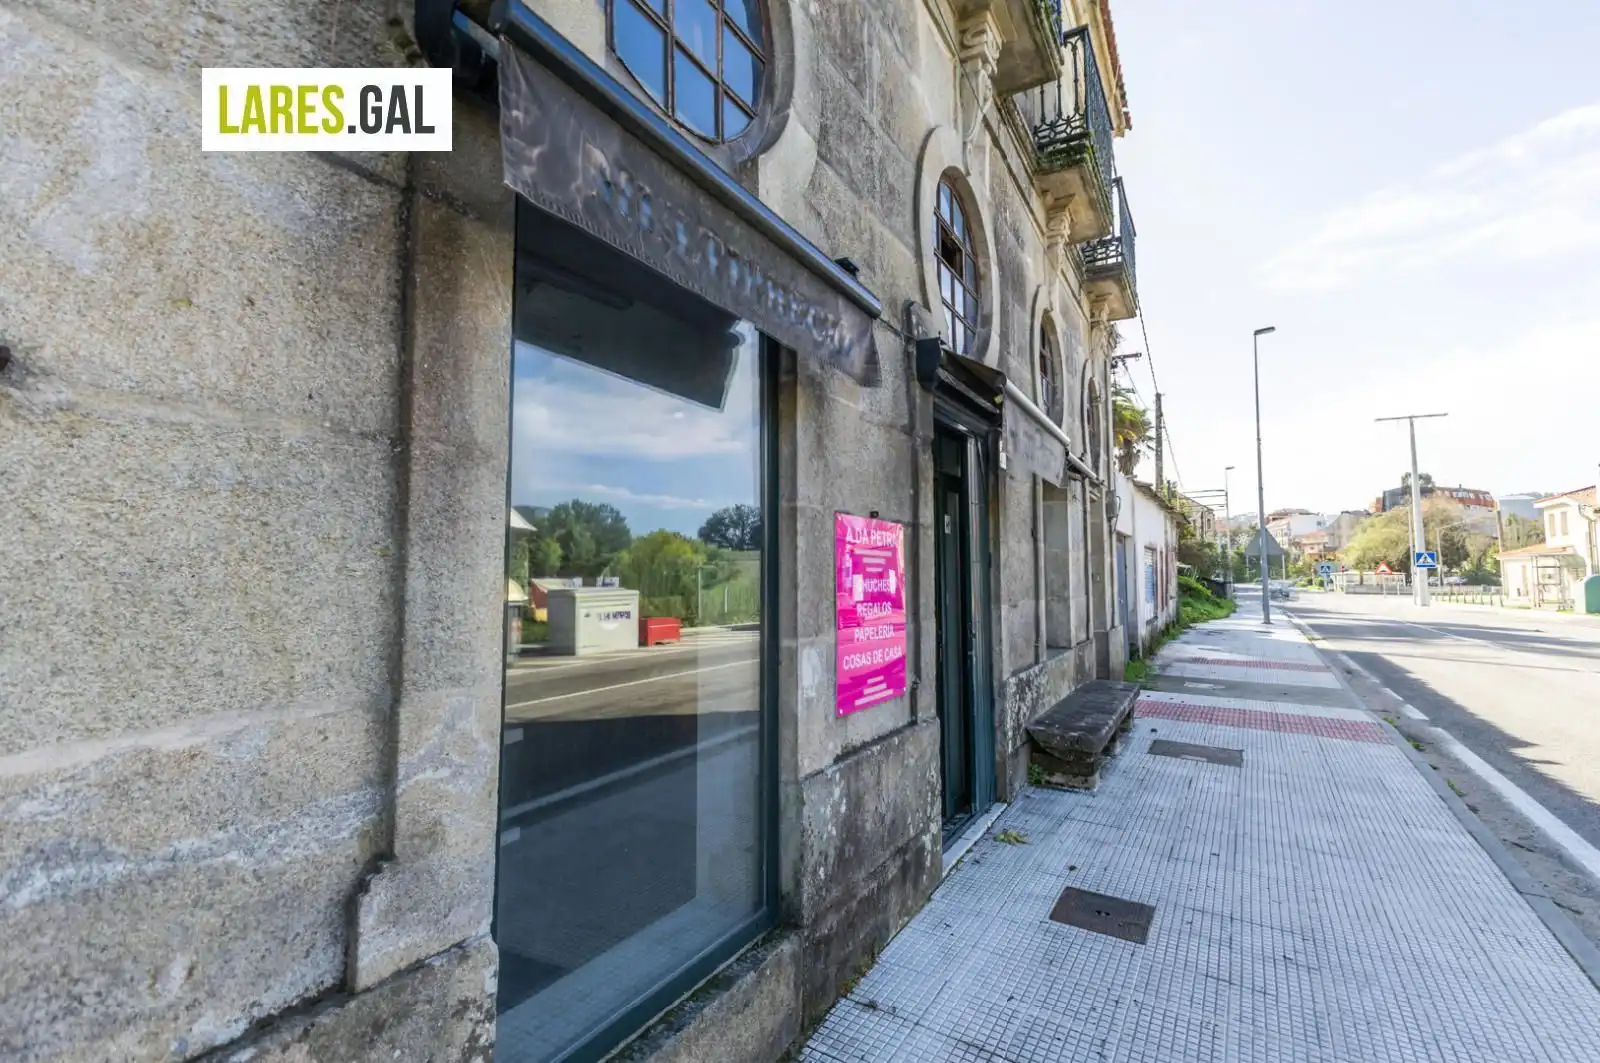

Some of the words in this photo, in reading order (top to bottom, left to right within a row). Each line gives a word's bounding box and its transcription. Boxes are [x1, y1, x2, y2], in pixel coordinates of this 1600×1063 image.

[856, 601, 892, 617] REGALOS
[843, 652, 871, 669] COSAS
[872, 648, 882, 665] DE
[883, 646, 902, 662] CASA
